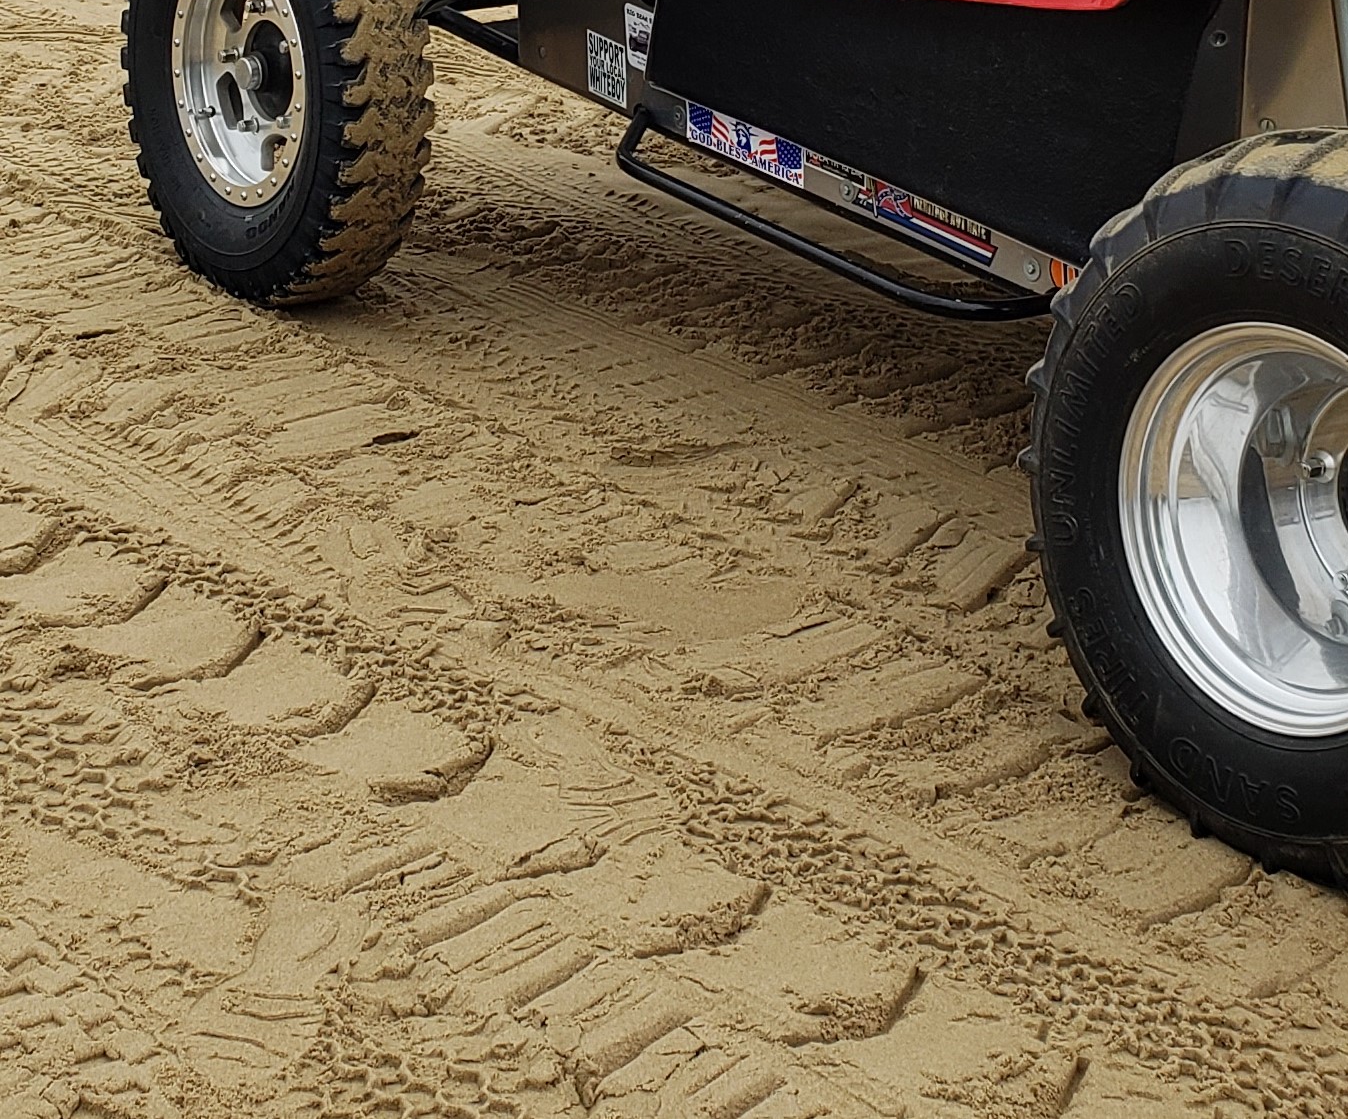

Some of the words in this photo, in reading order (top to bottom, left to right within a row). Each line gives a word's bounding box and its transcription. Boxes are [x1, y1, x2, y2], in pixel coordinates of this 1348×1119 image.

[588, 32, 624, 69] SUPPORT
[589, 54, 605, 71] YOUR
[606, 62, 625, 80] LOCAL
[589, 65, 626, 103] WHITEBOY
[691, 129, 713, 147] GOD
[716, 137, 748, 162] BLESS
[751, 155, 800, 185] AMERICA
[1050, 281, 1146, 549] UNLIMITED
[1067, 585, 1150, 727] TIRES
[1167, 735, 1302, 825] SAND
